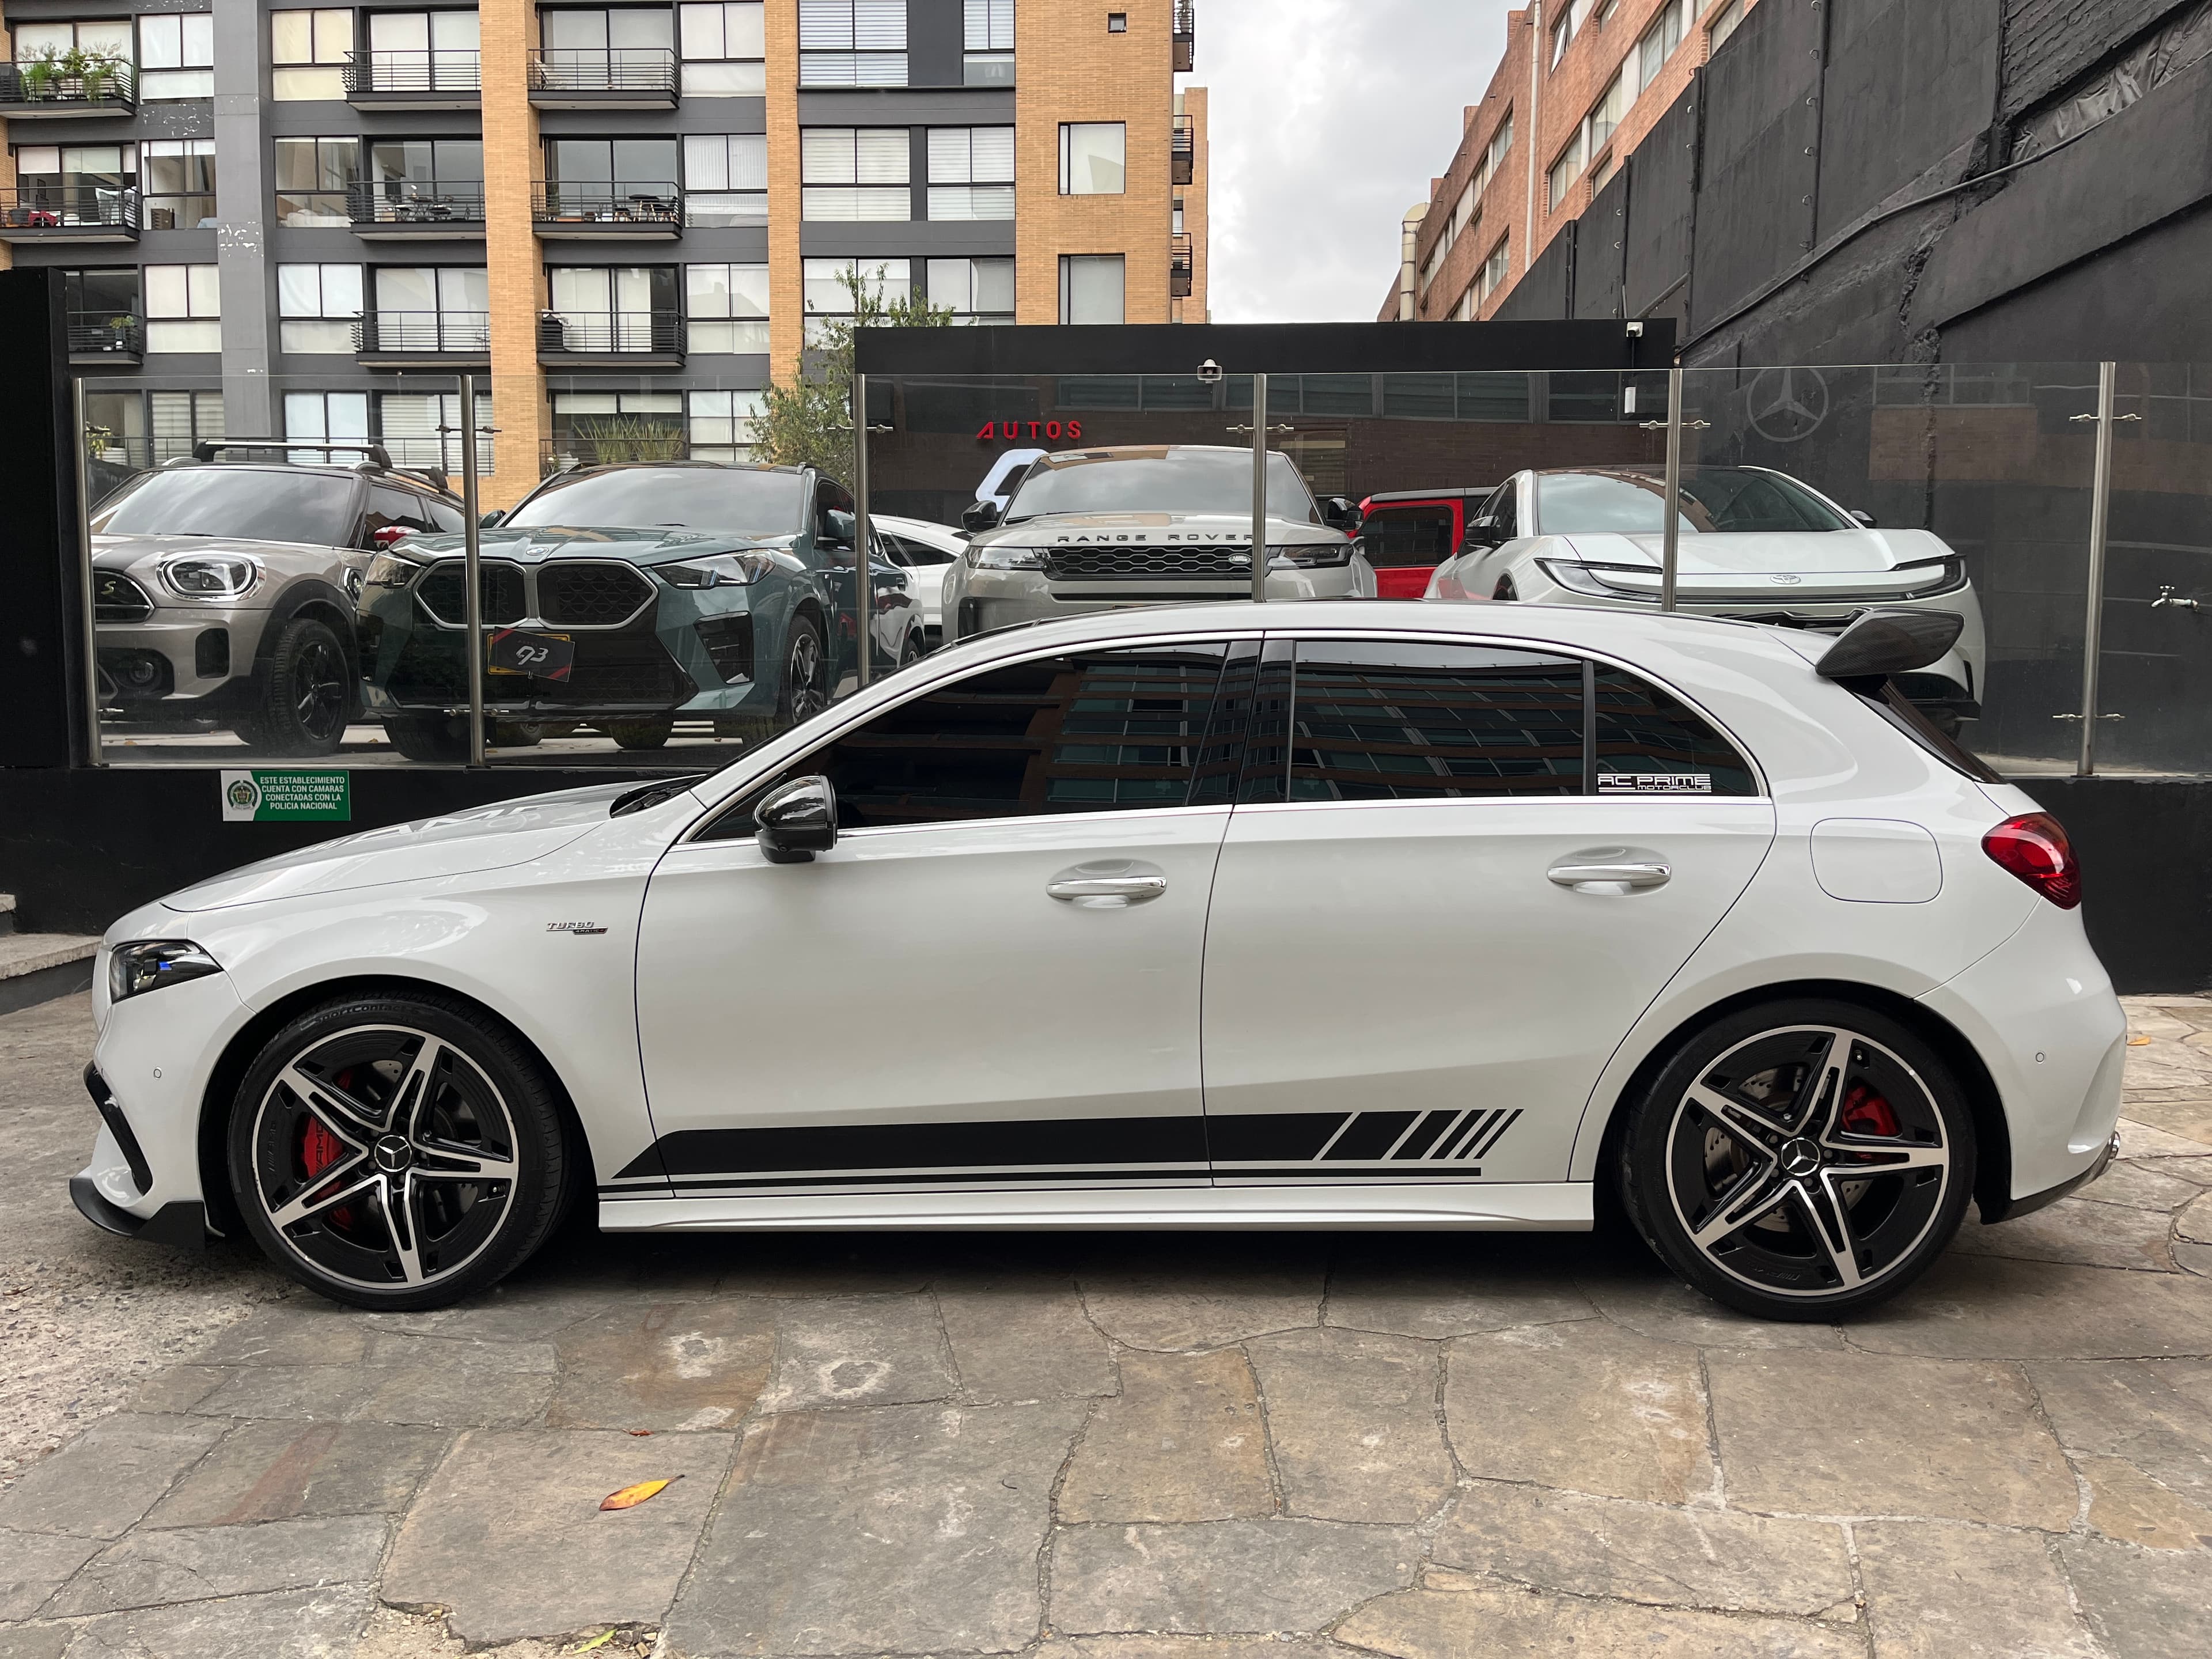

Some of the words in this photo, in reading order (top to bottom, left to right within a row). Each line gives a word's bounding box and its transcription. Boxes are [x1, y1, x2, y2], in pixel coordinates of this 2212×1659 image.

[976, 421, 1082, 440] AUTOS
[1597, 776, 1632, 785] AC
[1637, 776, 1711, 785] PRIME
